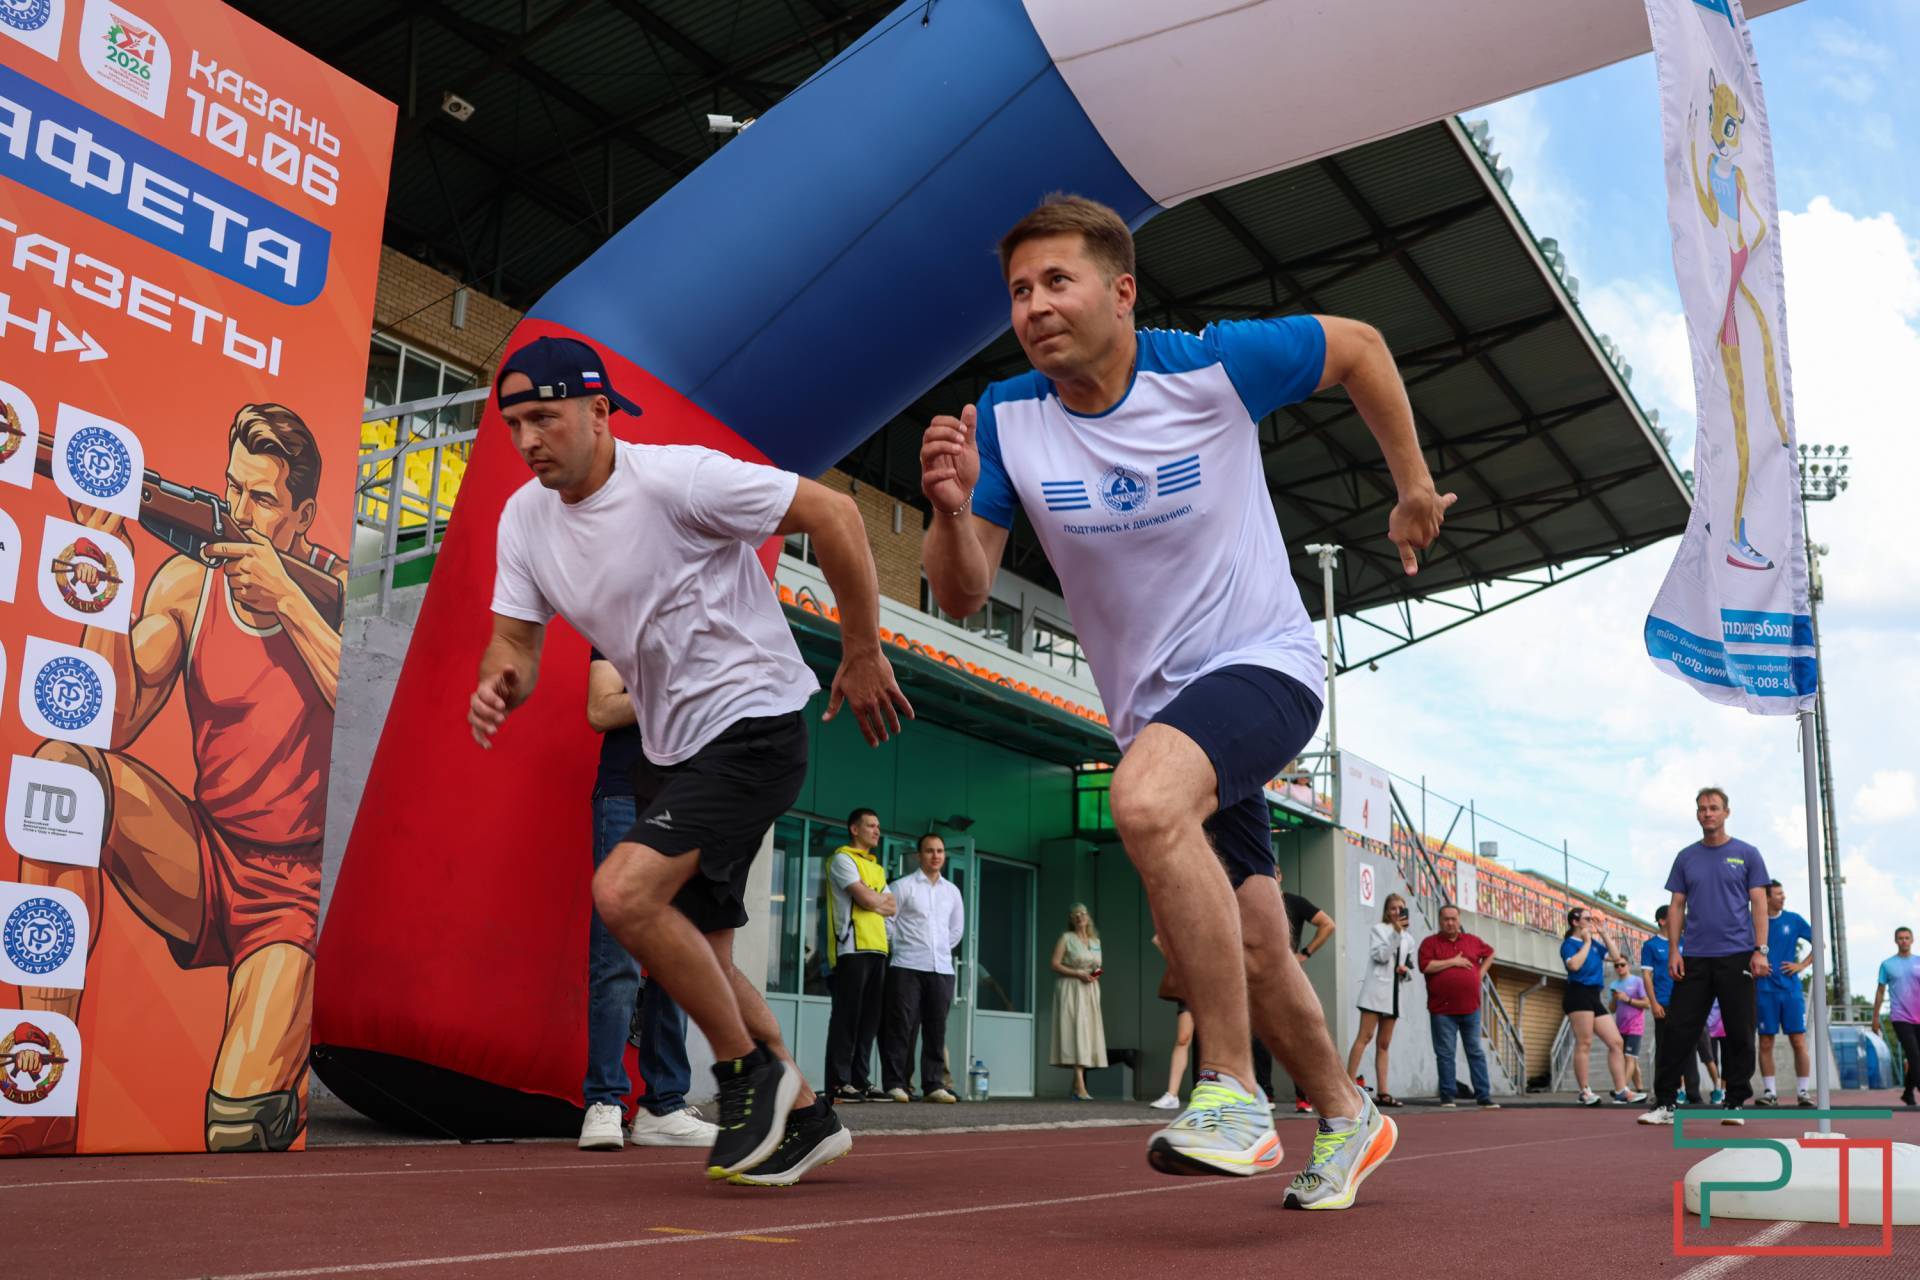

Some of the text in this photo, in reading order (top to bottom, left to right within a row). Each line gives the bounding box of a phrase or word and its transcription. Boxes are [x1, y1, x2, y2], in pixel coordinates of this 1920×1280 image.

[106, 45, 150, 80] 2026
[189, 50, 341, 157] КАЗАНЬ
[187, 88, 339, 207] 10.06
[67, 428, 132, 497] ТРУДОВЫЕ РЕЗЕРВЫ СТАДИОН
[1063, 504, 1194, 534] ПОДТЯНИСЬ К ДВИЖЕНИЮ!
[35, 658, 102, 729] ТРУДОВЫЕ РЕЗЕРВЫ СТАДИОН
[24, 782, 77, 824] ГТО
[4, 899, 74, 973] ТРУДОВЫЕ РЕЗЕРВЫ СТАДИОН
